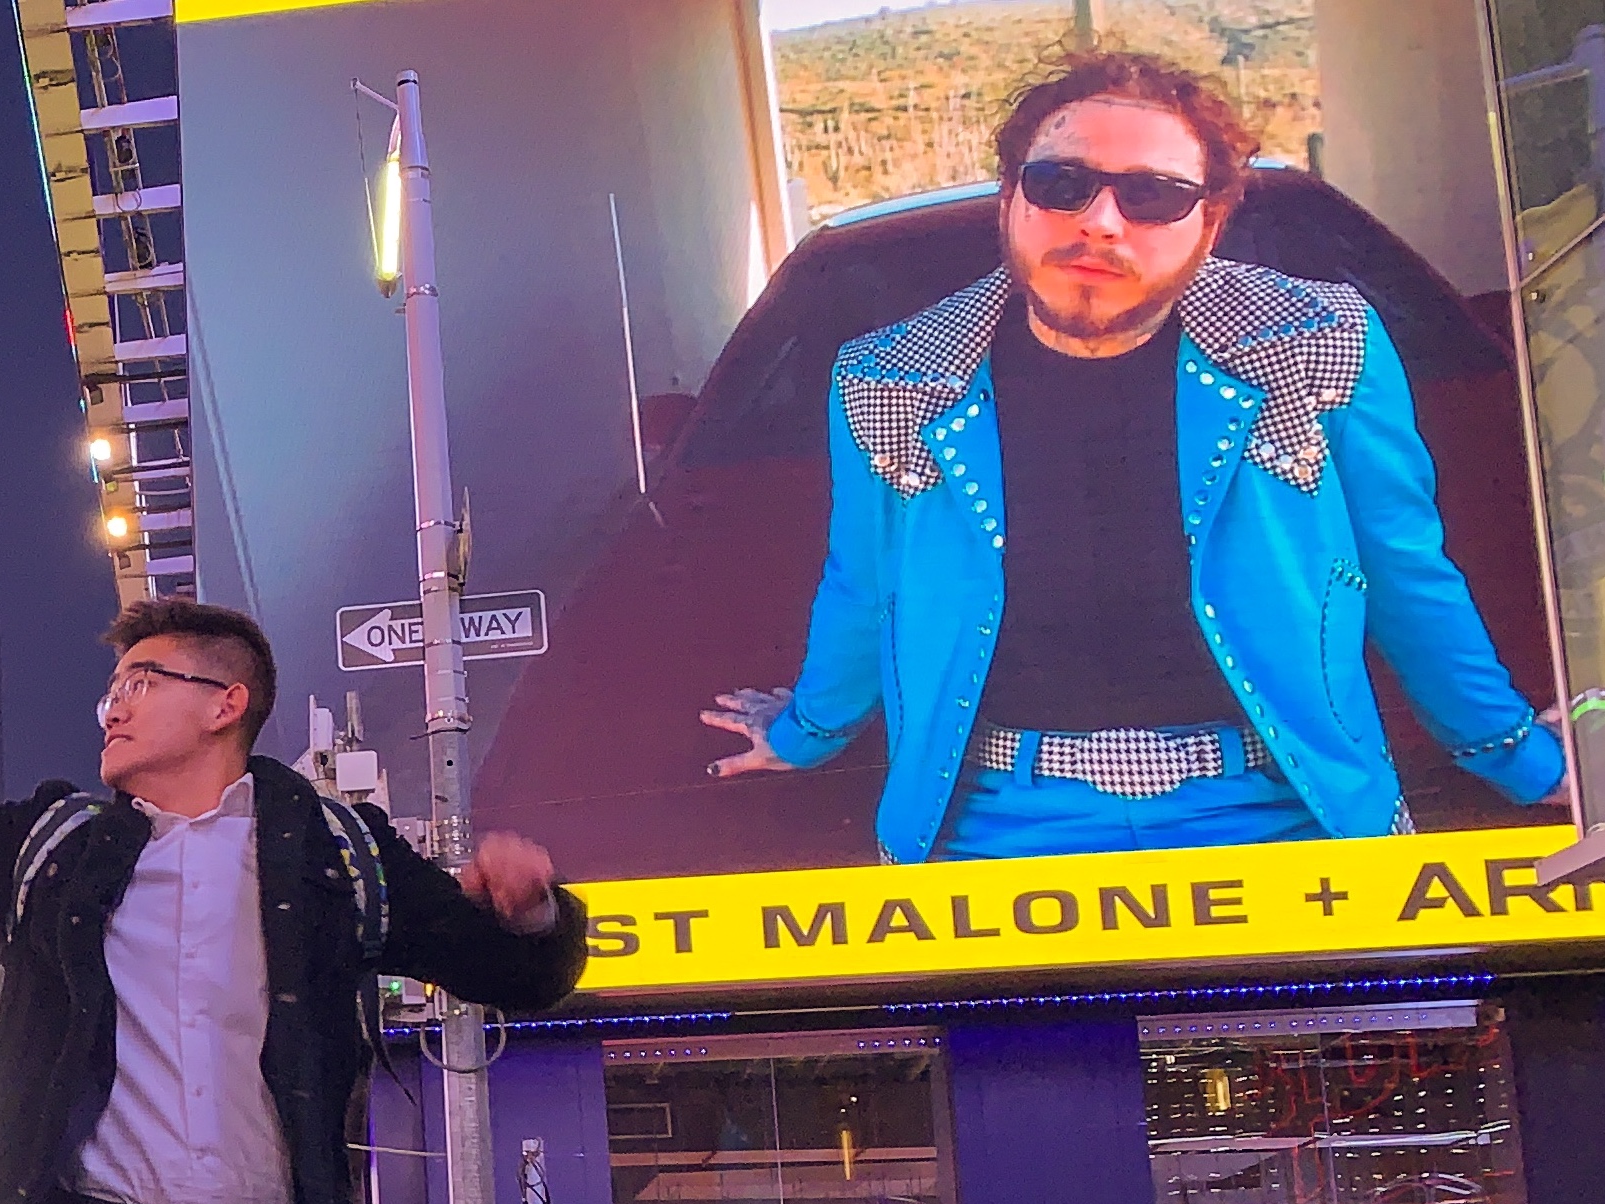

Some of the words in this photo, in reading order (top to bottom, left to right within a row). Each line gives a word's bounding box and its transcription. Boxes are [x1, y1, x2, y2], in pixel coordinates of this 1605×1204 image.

[367, 620, 423, 648] ONE
[460, 611, 523, 639] WAY
[762, 877, 1249, 949] MALONE
[1304, 876, 1349, 917] +
